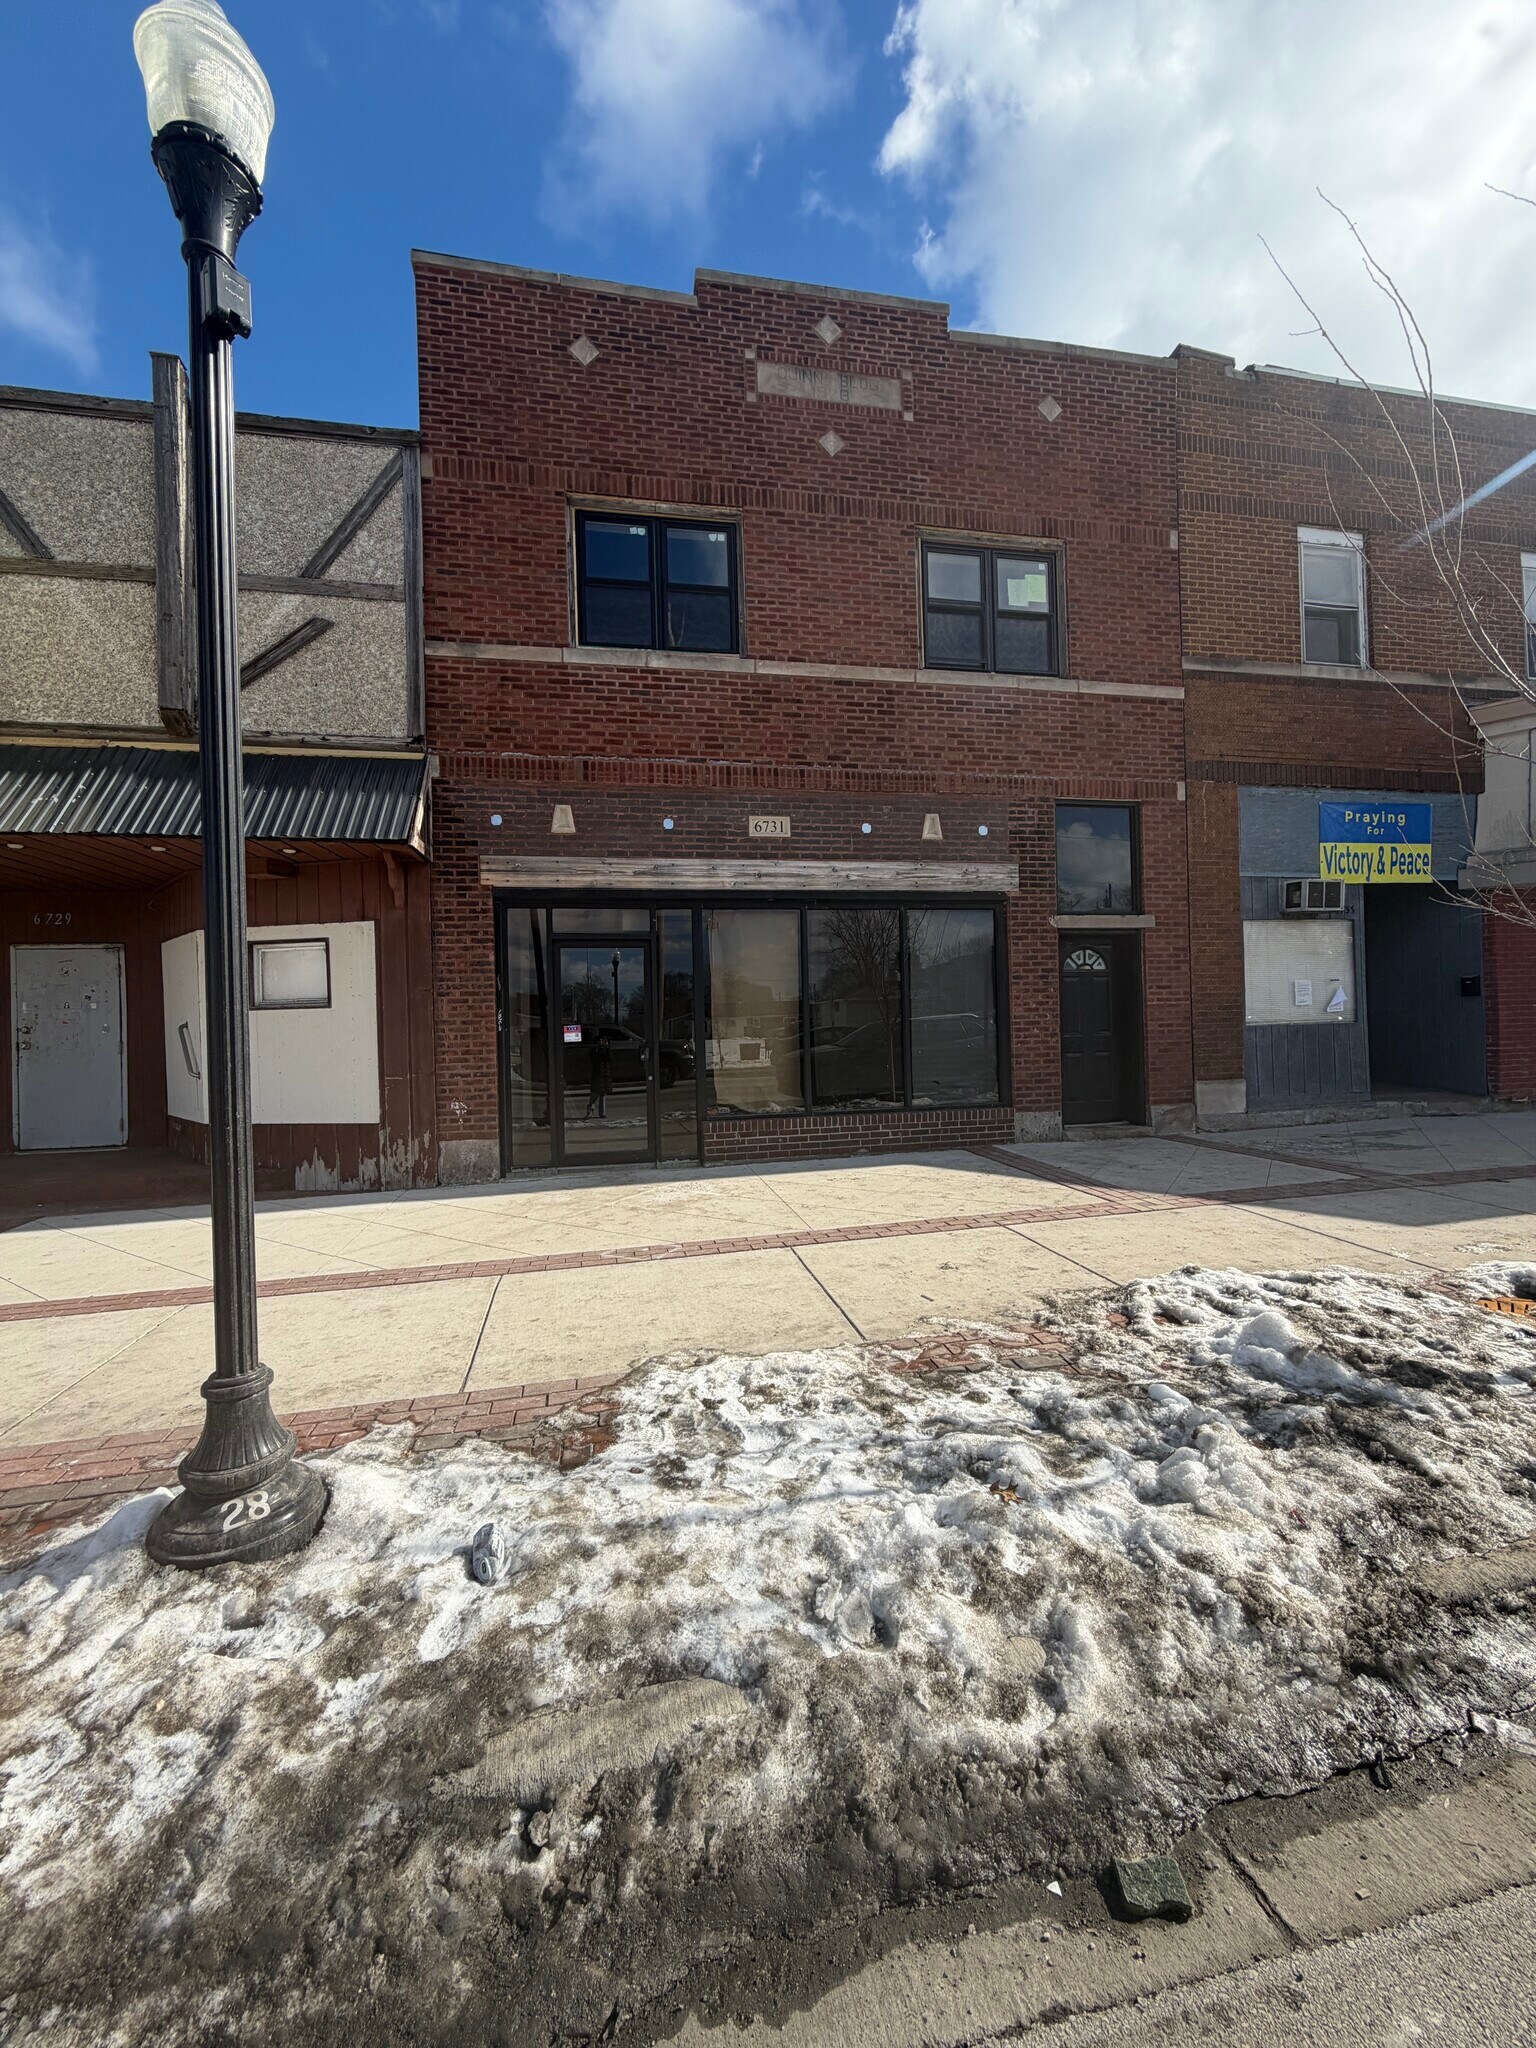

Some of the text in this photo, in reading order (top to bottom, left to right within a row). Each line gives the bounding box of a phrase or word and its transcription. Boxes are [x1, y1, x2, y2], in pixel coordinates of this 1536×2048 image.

[777, 366, 879, 391] QUINN BLDG
[1344, 810, 1406, 826] Praying
[754, 820, 784, 833] 6731
[1366, 826, 1385, 835] For
[1322, 844, 1430, 882] Victory & Peace
[33, 912, 72, 925] 6729
[220, 1490, 271, 1534] 28
